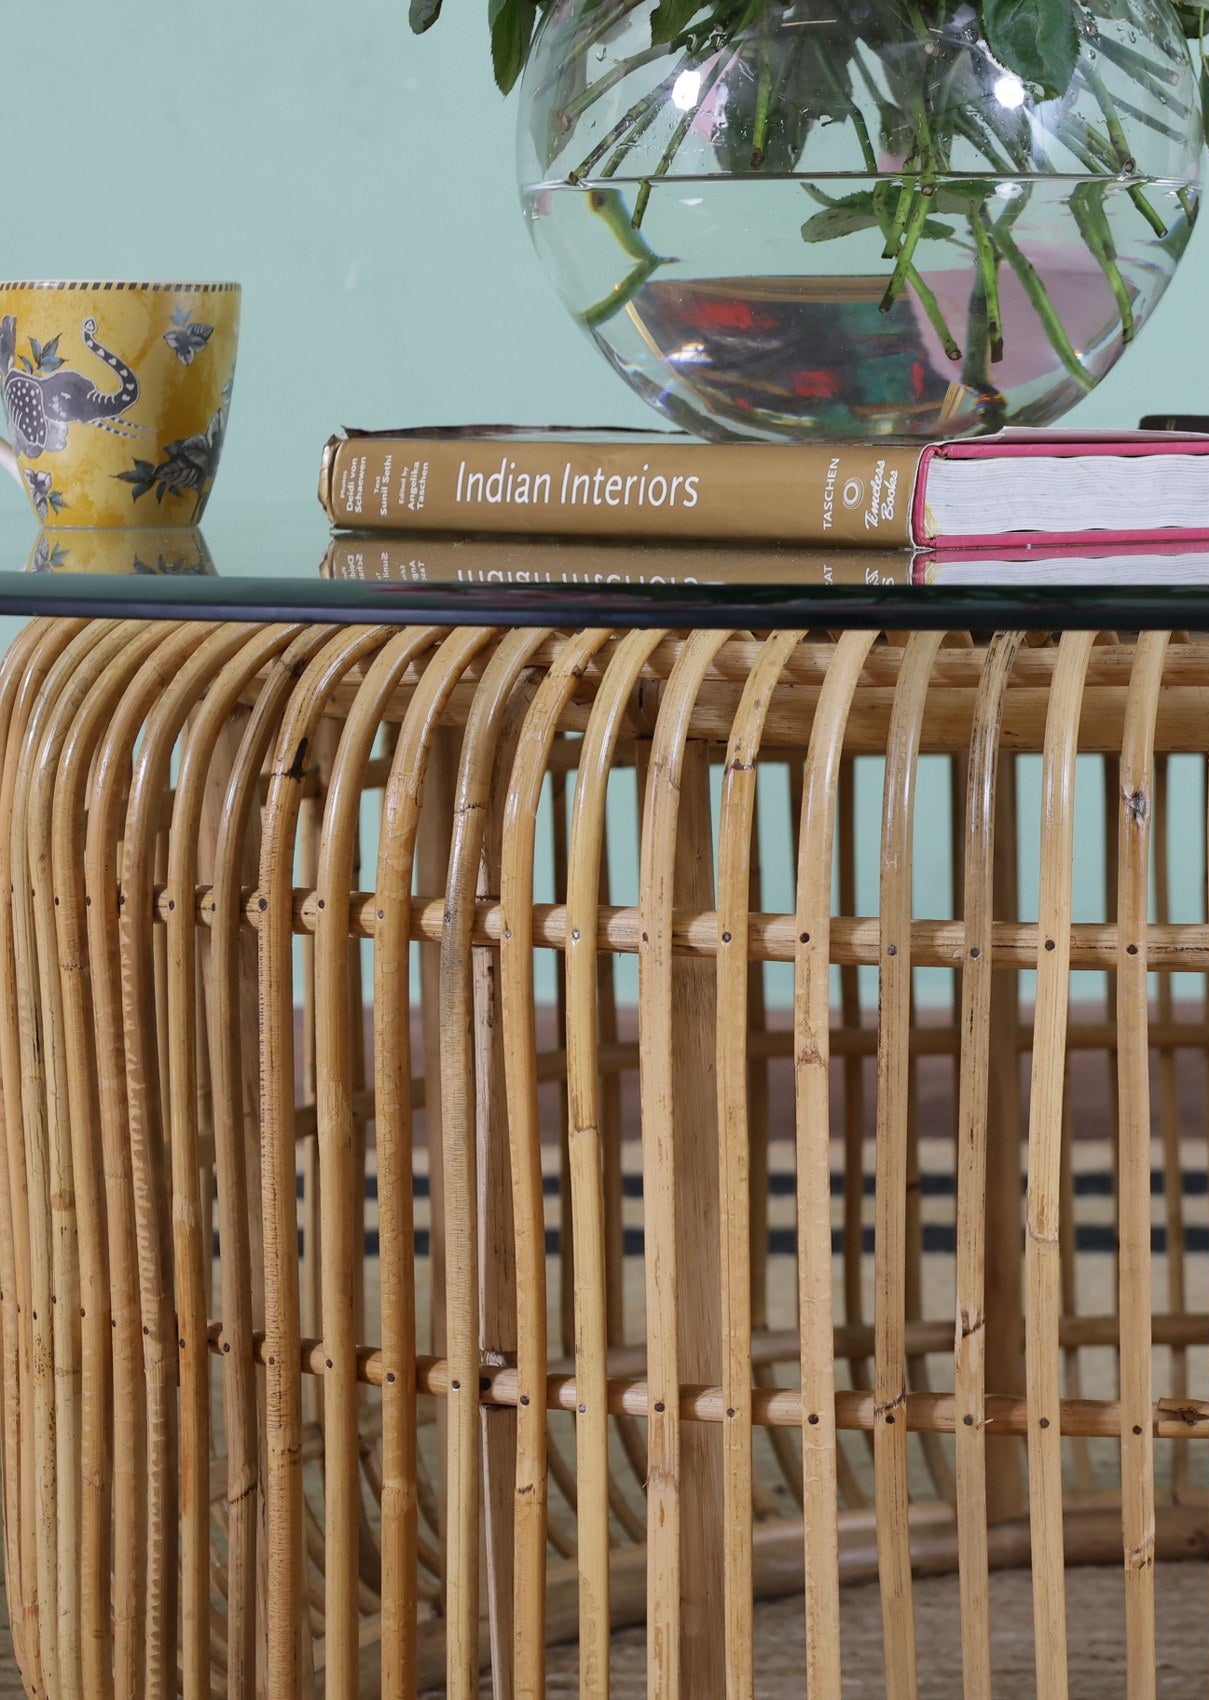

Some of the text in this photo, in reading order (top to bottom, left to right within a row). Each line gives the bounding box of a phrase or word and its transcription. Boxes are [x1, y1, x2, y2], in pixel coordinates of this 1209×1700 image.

[346, 457, 358, 511] Deidi von
[355, 456, 366, 513] Schaewen
[380, 455, 392, 516] Sunil Sethi
[399, 466, 409, 504] Edited by
[408, 461, 420, 510] Angelika
[417, 462, 429, 510] Taschen
[456, 458, 700, 507] Indian Interiors
[823, 458, 840, 530] TASCHEN
[864, 459, 886, 529] Timeless
[881, 469, 898, 520] Books
